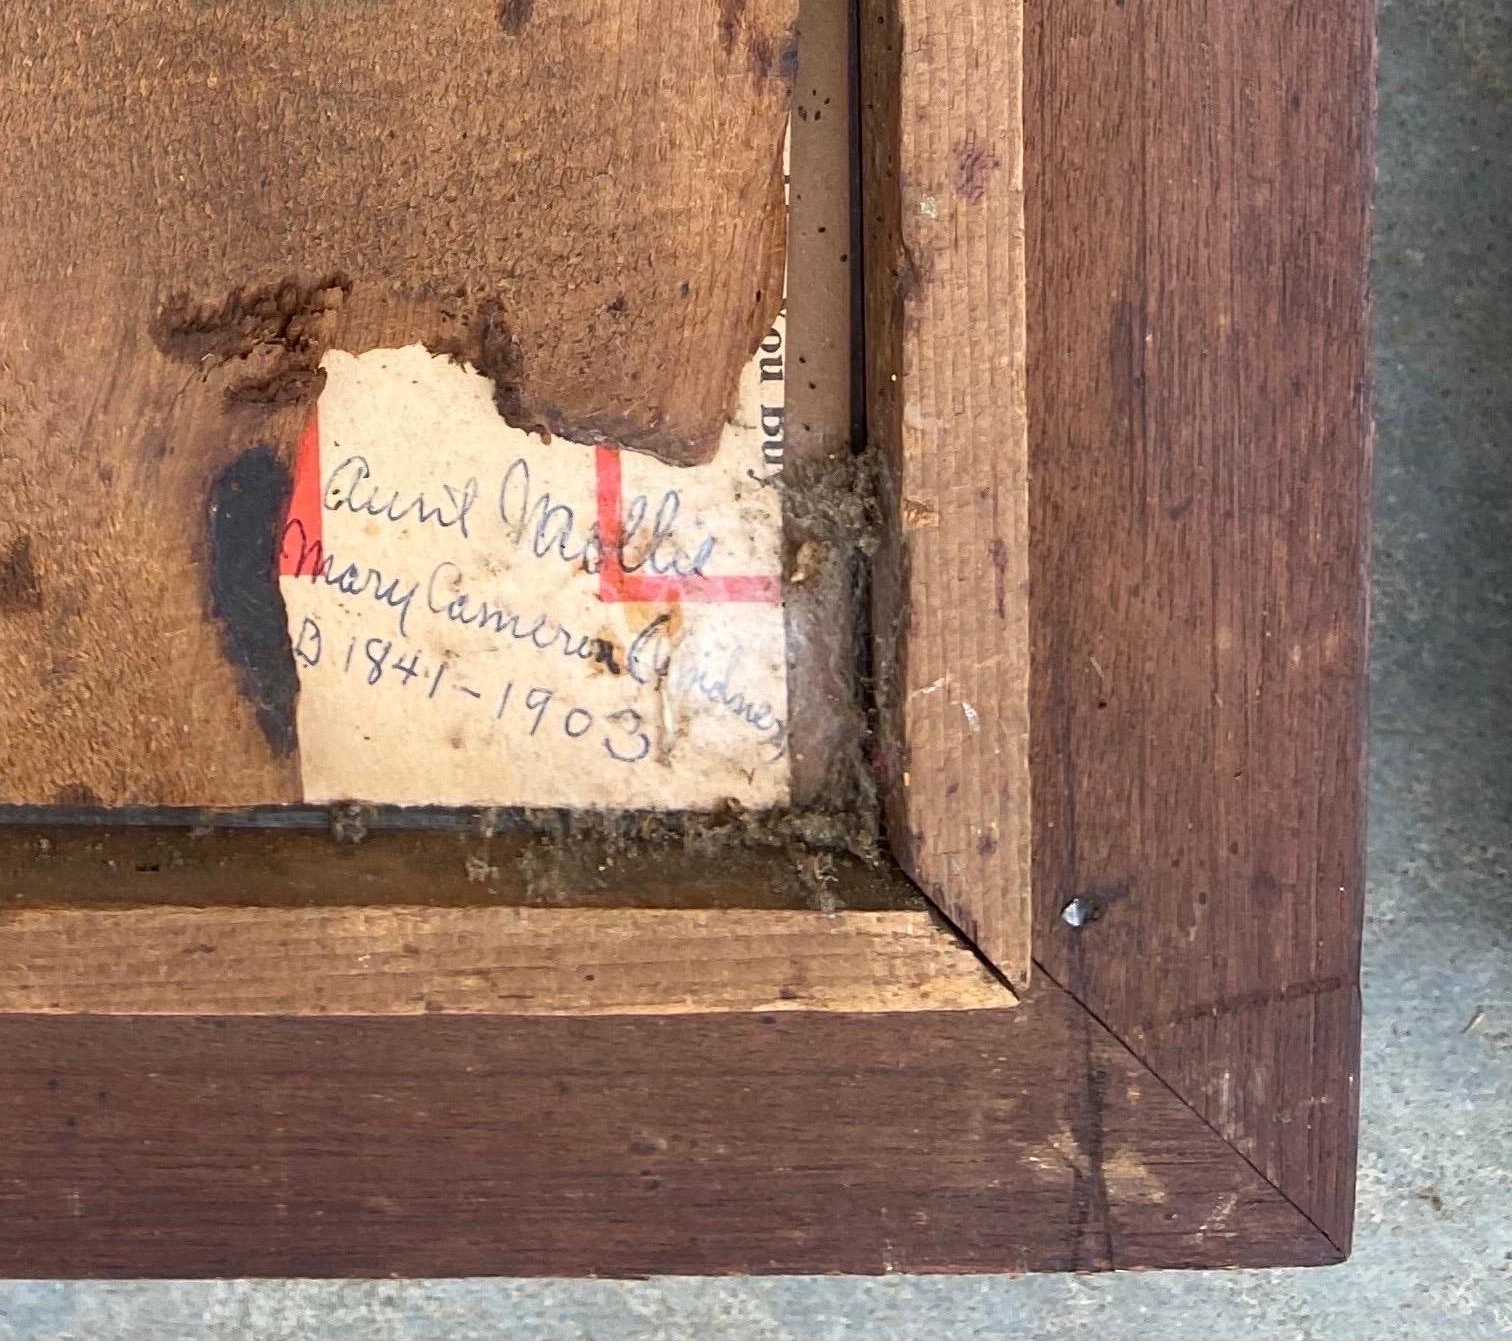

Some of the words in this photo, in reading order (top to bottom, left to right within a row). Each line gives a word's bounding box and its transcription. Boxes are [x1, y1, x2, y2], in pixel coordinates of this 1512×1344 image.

[760, 297, 785, 384] ou
[323, 455, 479, 539] Aunt
[279, 518, 421, 638] Mary
[427, 561, 621, 676] Cameron
[293, 617, 323, 668] B
